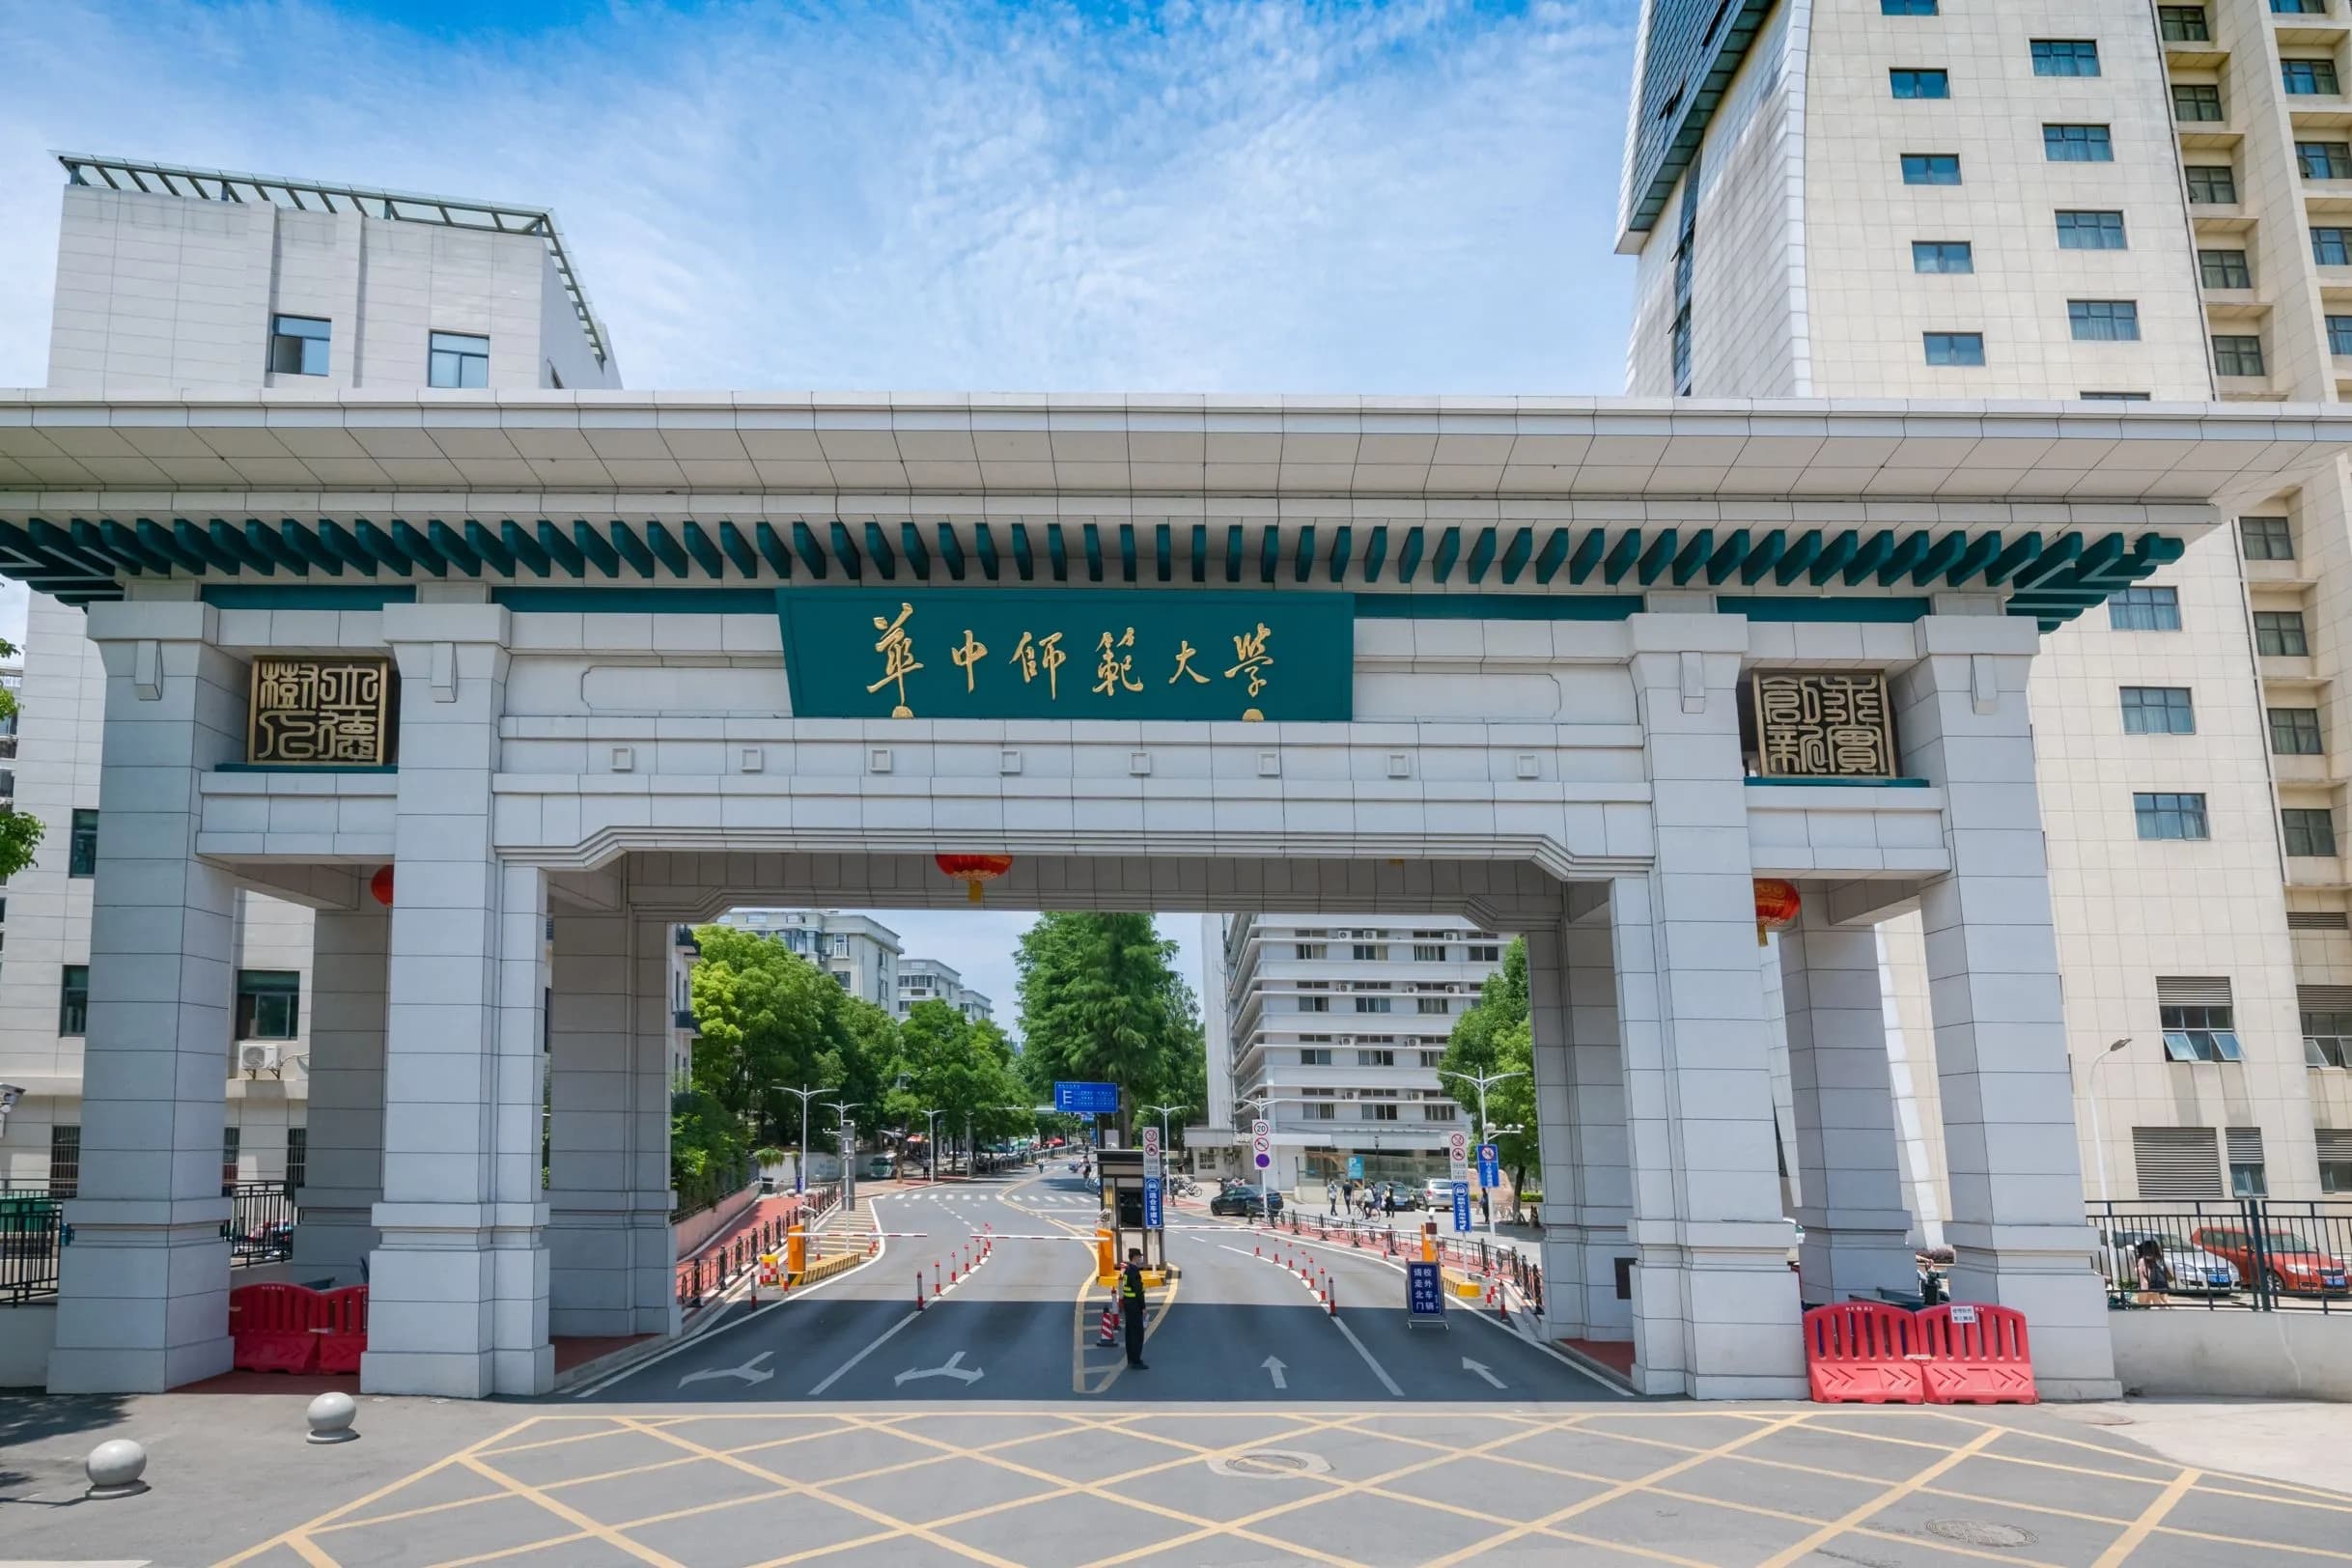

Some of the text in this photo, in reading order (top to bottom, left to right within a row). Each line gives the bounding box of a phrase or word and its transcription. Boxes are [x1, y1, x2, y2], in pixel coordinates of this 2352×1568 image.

[865, 602, 1275, 706] 華中師範大學
